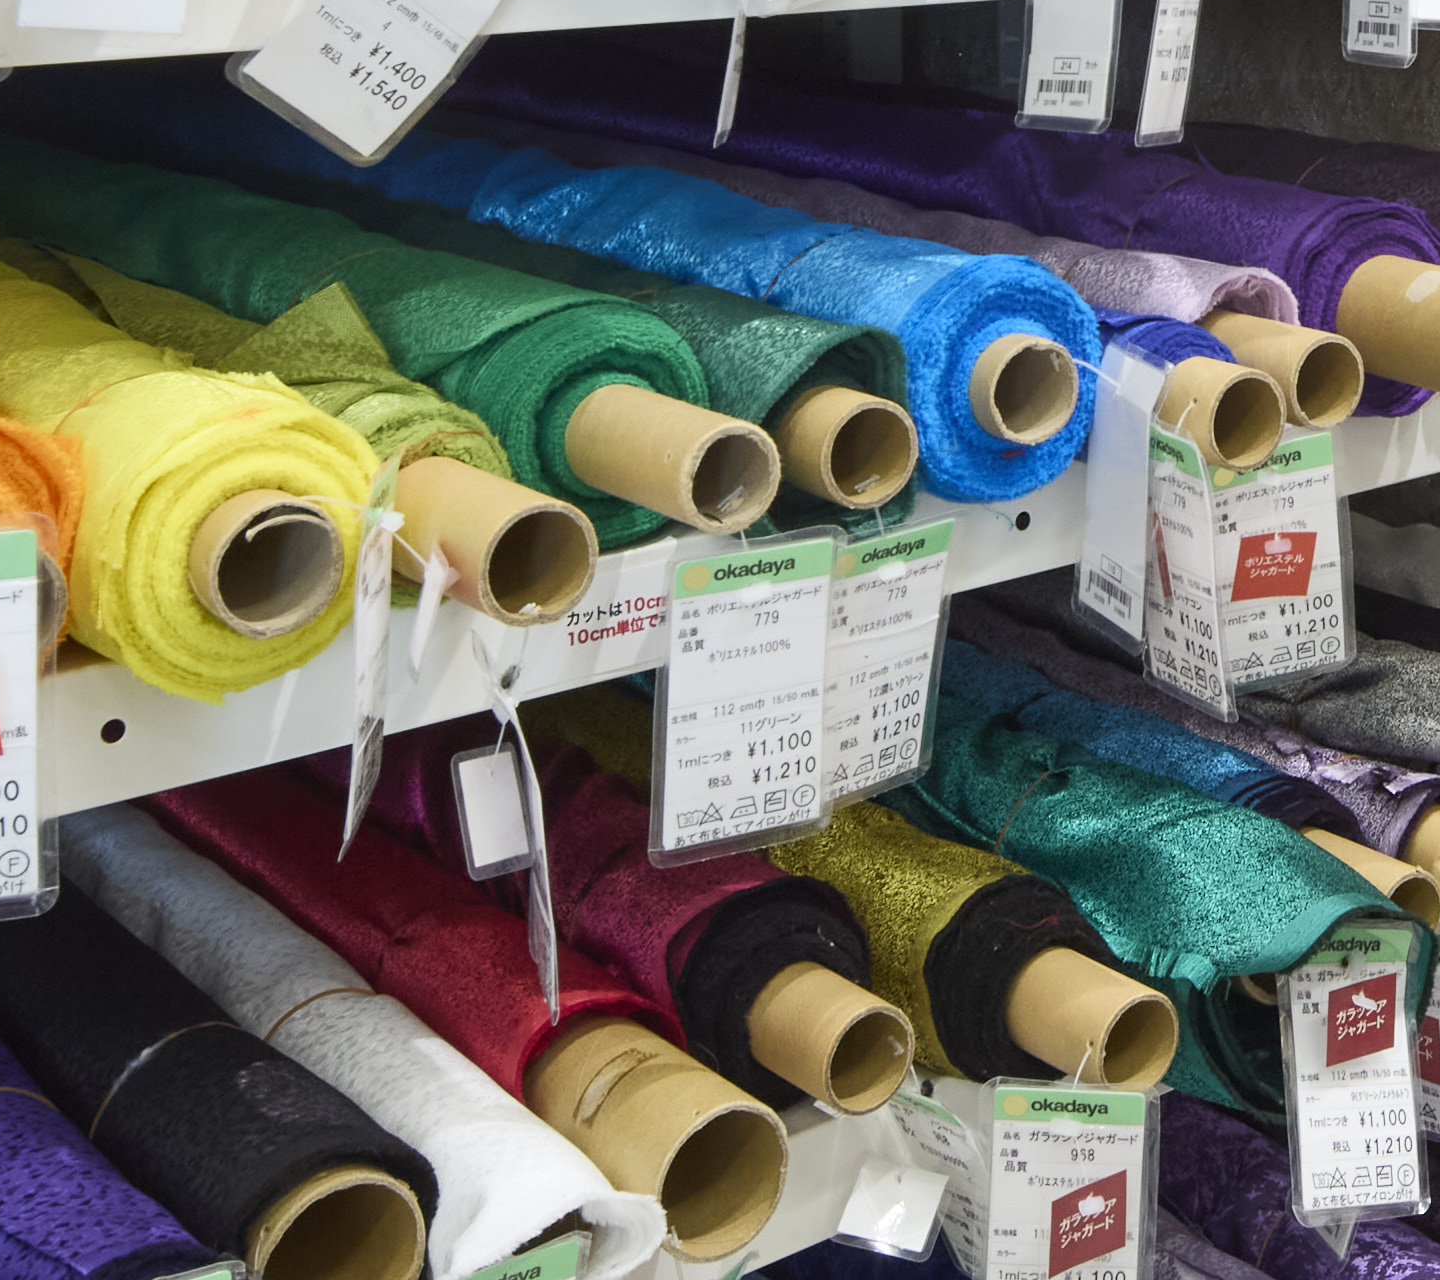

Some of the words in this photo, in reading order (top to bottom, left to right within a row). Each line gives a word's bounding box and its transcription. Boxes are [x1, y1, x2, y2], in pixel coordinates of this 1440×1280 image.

[368, 39, 427, 91] ¥1,400
[349, 60, 408, 112] ¥1,540
[861, 535, 926, 564] okadaya
[712, 554, 796, 582] okadaya
[886, 585, 908, 602] 779
[1278, 593, 1335, 619] ¥1,100
[754, 609, 780, 627] 779
[1284, 614, 1340, 639] ¥1,210
[872, 690, 921, 721] ¥1,100
[739, 709, 803, 734] 11グリーン
[873, 716, 922, 745] ¥1,210
[747, 728, 813, 760] ¥1,100
[752, 757, 817, 785] ¥1,210
[673, 808, 812, 849] あて布をしてアイロンがけ
[1336, 1013, 1387, 1040] ジャガード
[1030, 1096, 1110, 1119] okadaya
[1358, 1108, 1407, 1129] ¥1,100
[1364, 1134, 1414, 1155] ¥1,210
